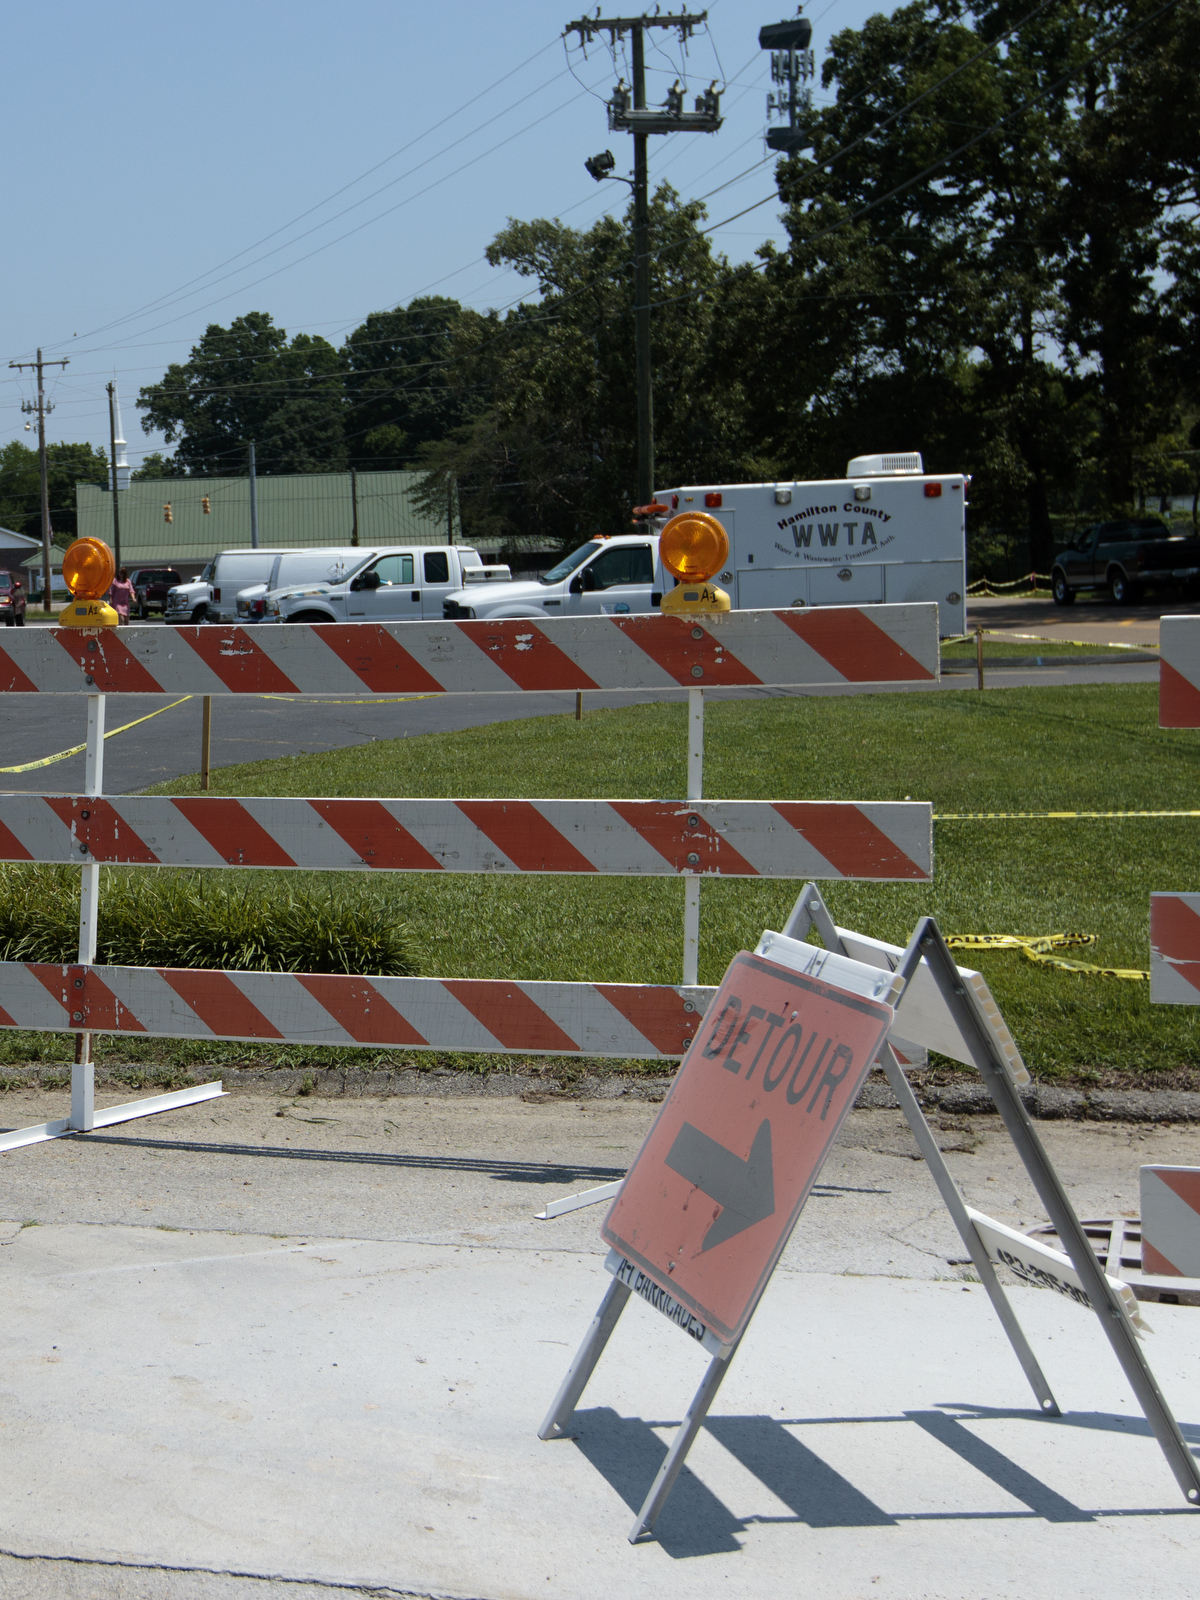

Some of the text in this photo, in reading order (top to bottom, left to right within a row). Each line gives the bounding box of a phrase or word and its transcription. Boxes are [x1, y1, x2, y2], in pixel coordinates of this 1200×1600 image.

[777, 503, 892, 530] Hamilton County
[792, 521, 877, 548] WWTA
[774, 541, 793, 556] Water
[803, 553, 841, 562] Wastewater
[844, 545, 878, 561] Treatment
[701, 995, 853, 1120] DETOUR
